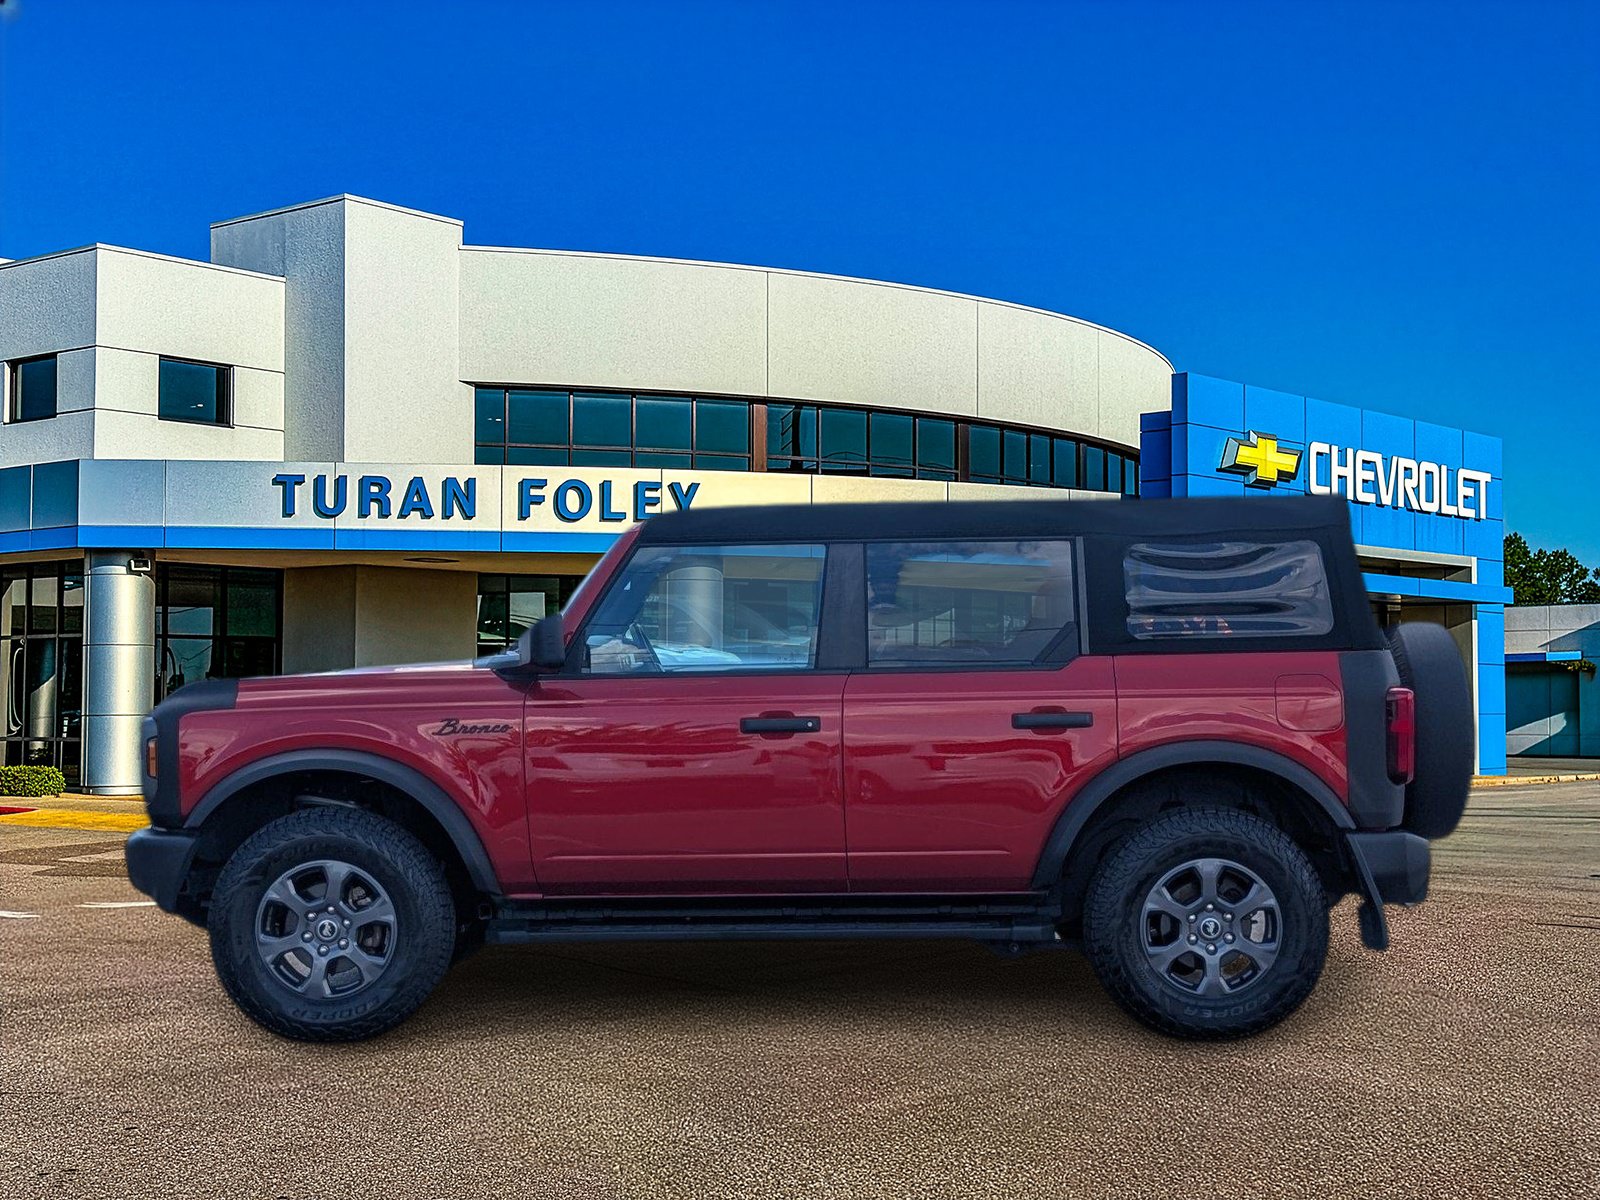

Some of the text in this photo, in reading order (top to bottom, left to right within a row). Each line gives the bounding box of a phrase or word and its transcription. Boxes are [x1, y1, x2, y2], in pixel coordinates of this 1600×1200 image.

[272, 473, 701, 523] TURAN FOLEY
[1308, 441, 1492, 520] CHEVROLET
[432, 718, 513, 736] Bronco
